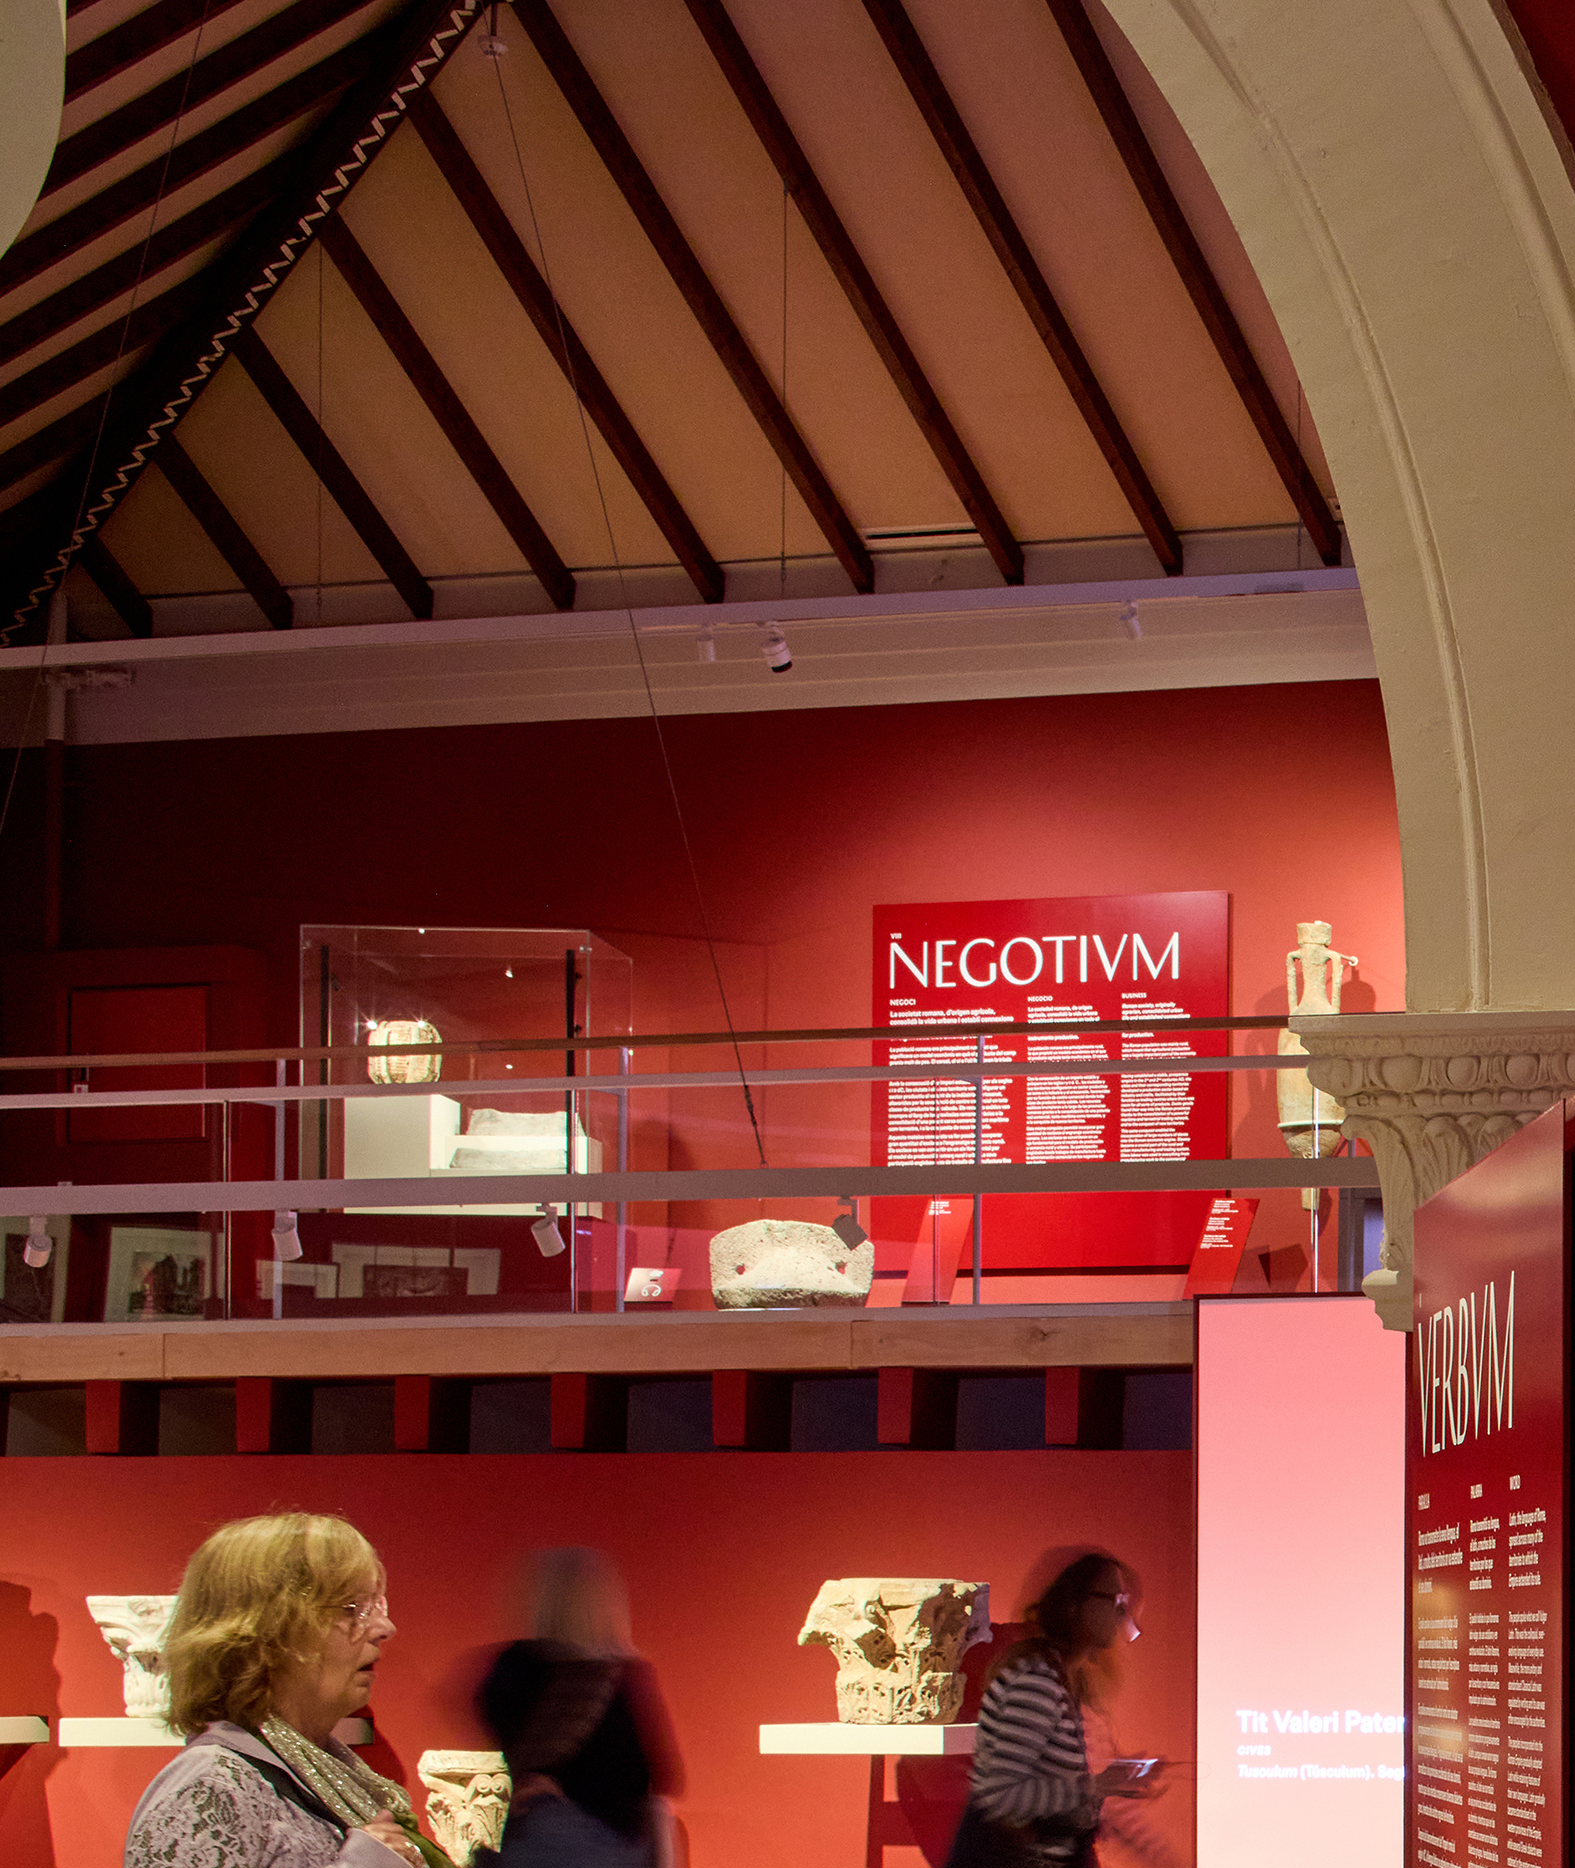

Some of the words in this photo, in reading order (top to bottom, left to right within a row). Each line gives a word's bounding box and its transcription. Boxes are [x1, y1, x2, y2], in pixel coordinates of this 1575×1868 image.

[889, 931, 1181, 990] NEGOTIVM
[1418, 1270, 1514, 1457] VERBVM
[1235, 1709, 1269, 1734] Tit
[1272, 1709, 1339, 1734] Valeri
[1237, 1764, 1298, 1778] Tusculum
